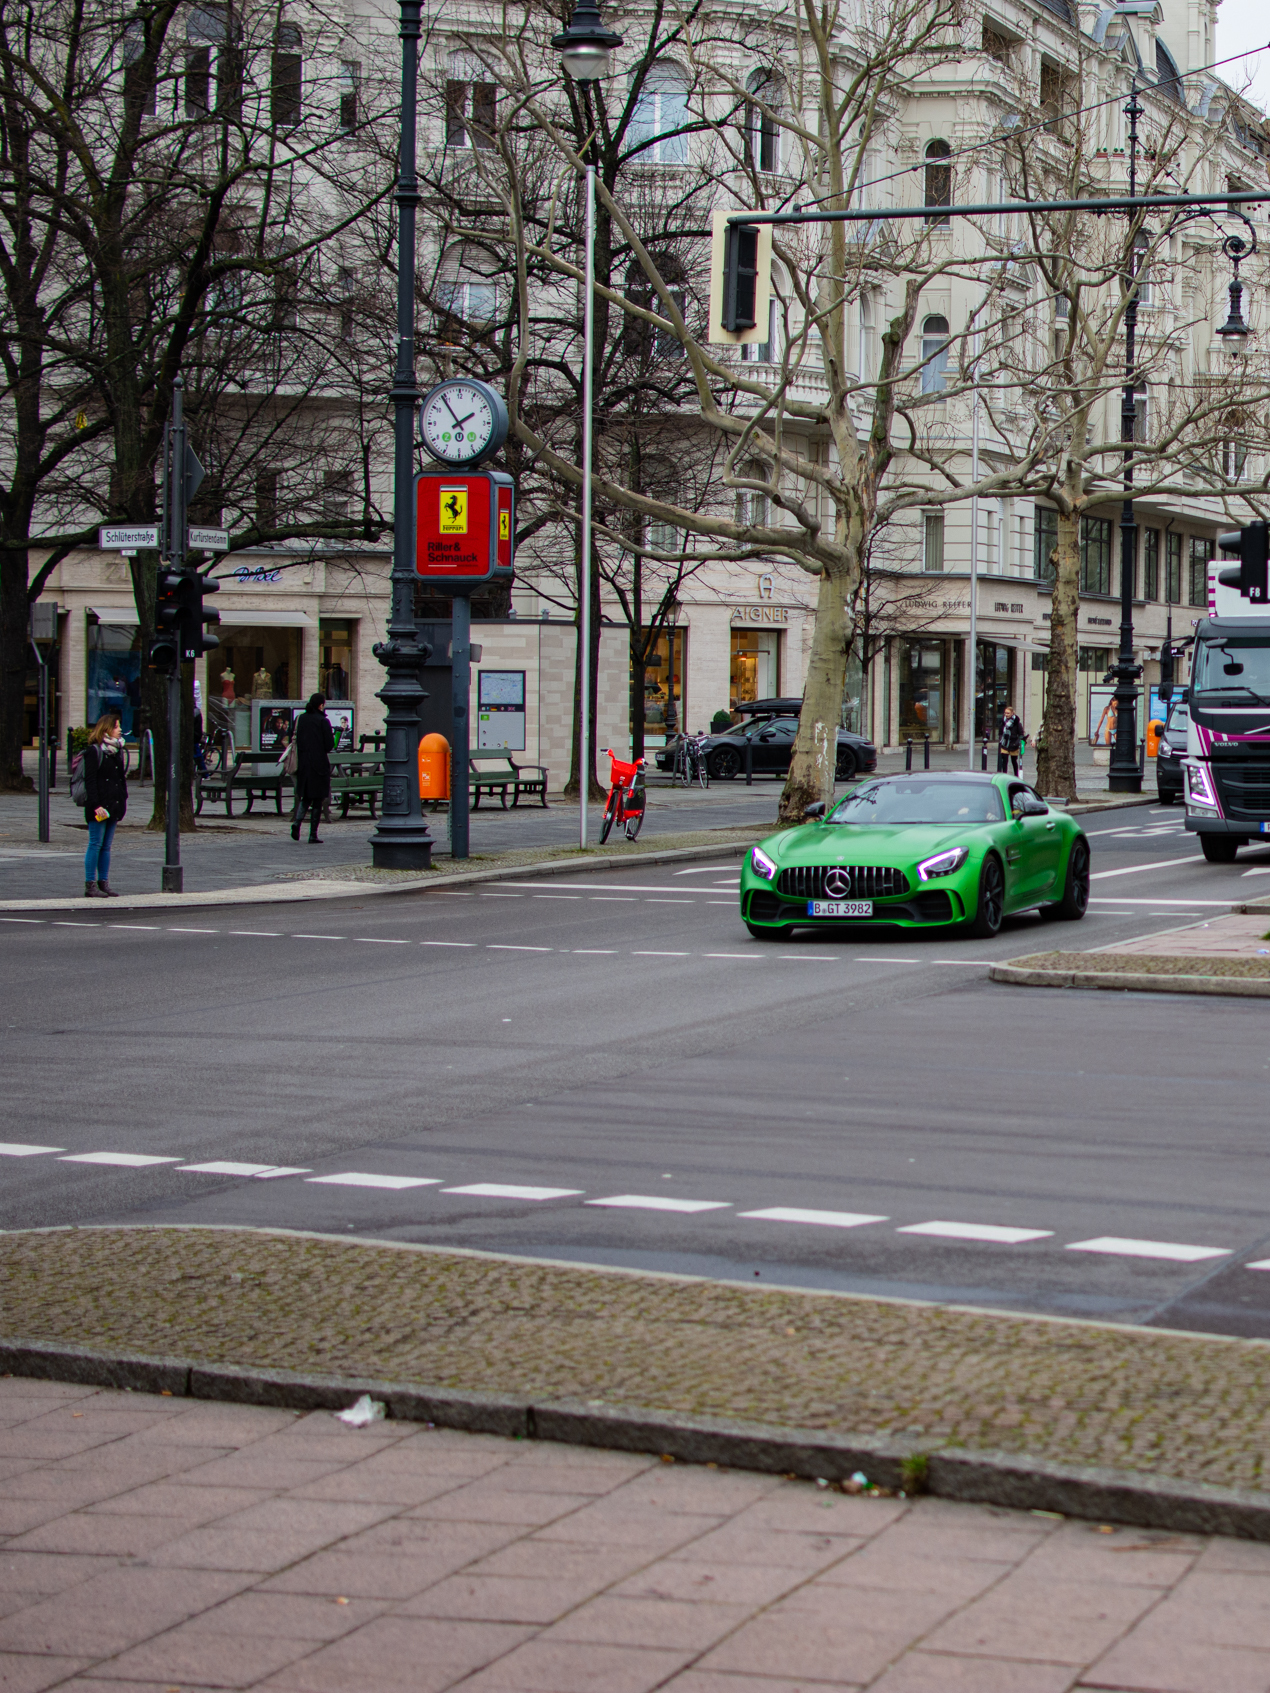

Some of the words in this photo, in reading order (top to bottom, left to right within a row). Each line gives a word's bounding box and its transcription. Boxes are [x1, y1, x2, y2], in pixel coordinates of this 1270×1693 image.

[105, 530, 155, 544] Schlüterstraße
[190, 531, 227, 545] Kurfürstendamm
[427, 552, 478, 562] Schnauck
[1249, 587, 1261, 597] F8
[731, 607, 789, 621] AIGNER
[185, 649, 195, 658] K6
[814, 903, 821, 914] B
[827, 903, 841, 914] GT
[843, 903, 871, 914] 3982
